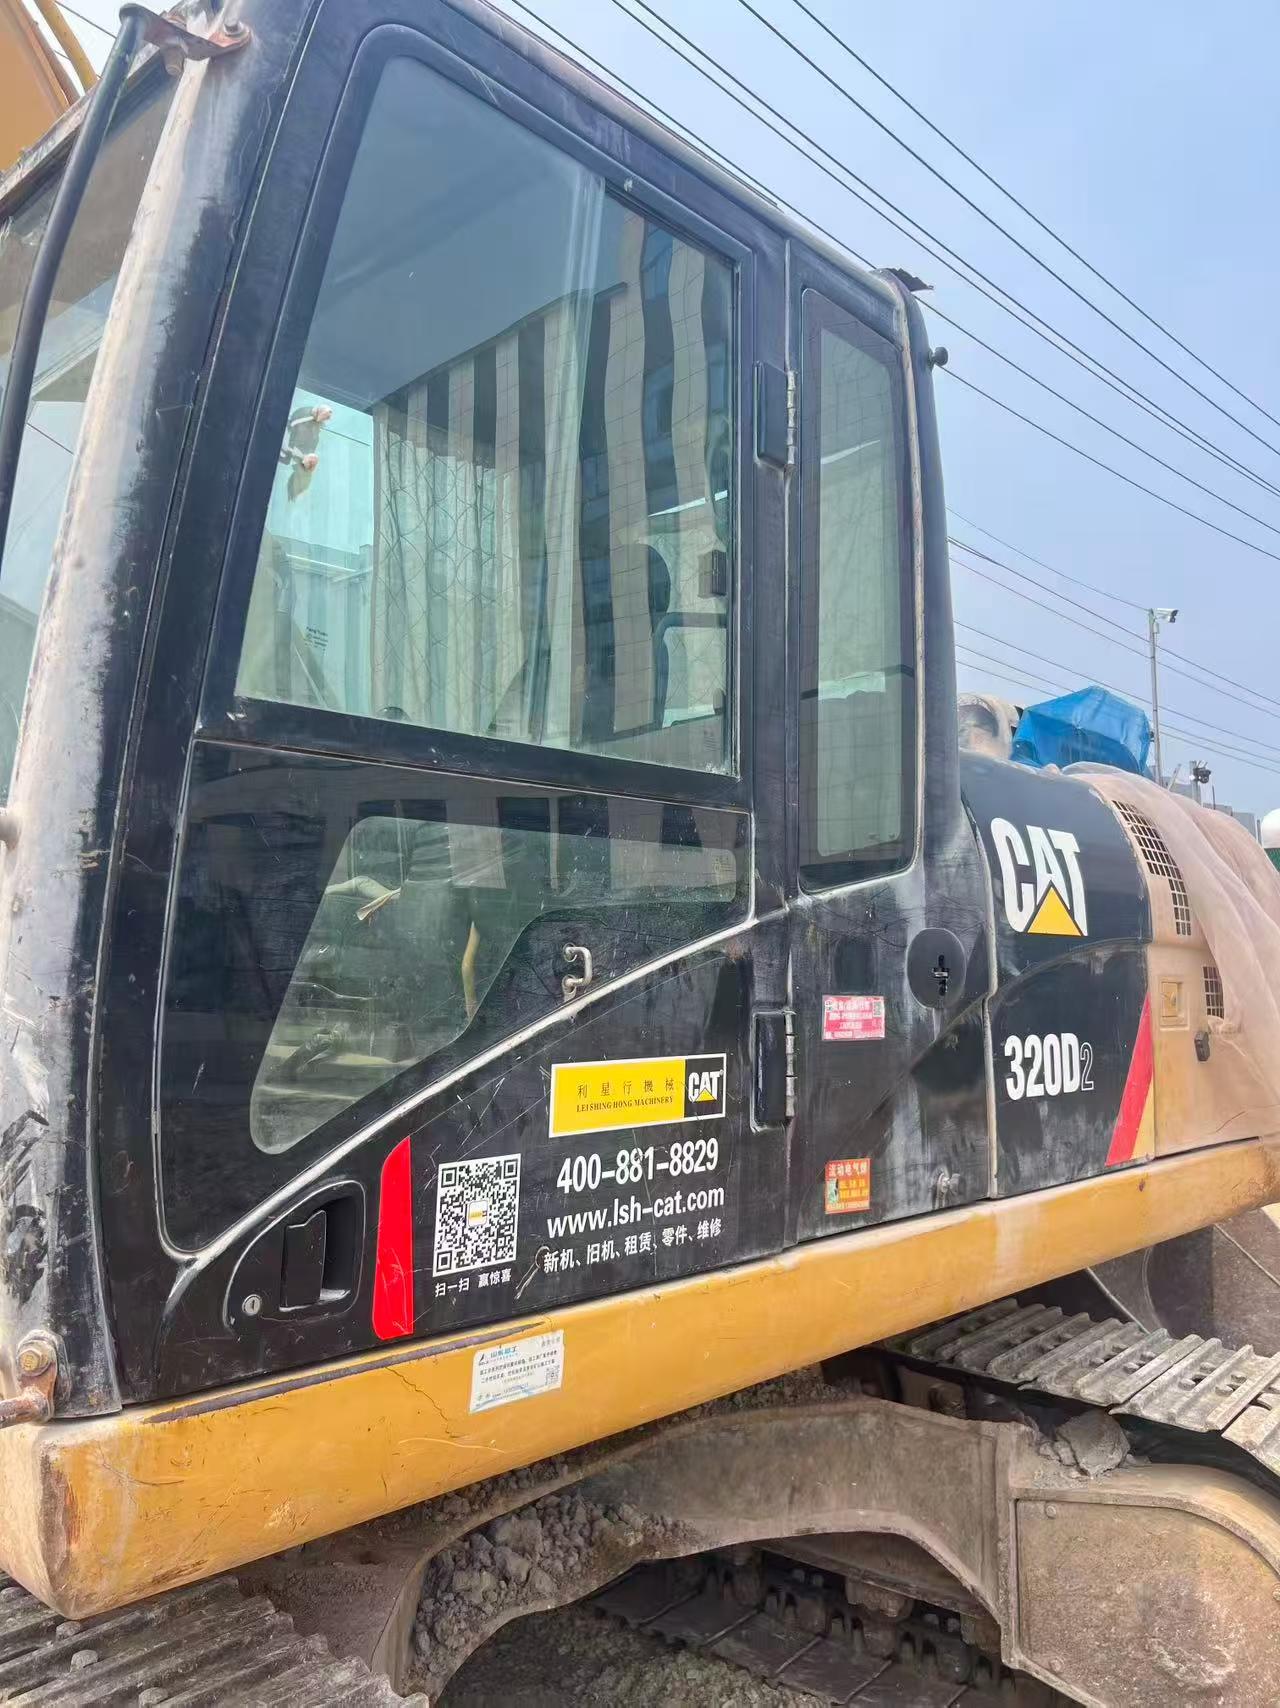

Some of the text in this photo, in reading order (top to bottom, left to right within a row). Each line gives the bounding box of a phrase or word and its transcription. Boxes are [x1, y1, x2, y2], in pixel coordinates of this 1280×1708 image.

[990, 817, 1088, 937] CAT
[577, 1076, 674, 1099] 利星行機械
[687, 1070, 721, 1103] CAT
[1004, 1032, 1095, 1101] 320D2
[590, 1101, 612, 1112] SHING
[613, 1099, 633, 1109] HONG
[634, 1095, 674, 1107] MACHINERY
[556, 1137, 719, 1194] 400-881-8829
[546, 1186, 725, 1239] www.lsh-cat.com
[543, 1217, 722, 1274] 新机、旧机、租赁、零件、维修
[434, 1268, 512, 1297] 扫一扫 赢惊喜
